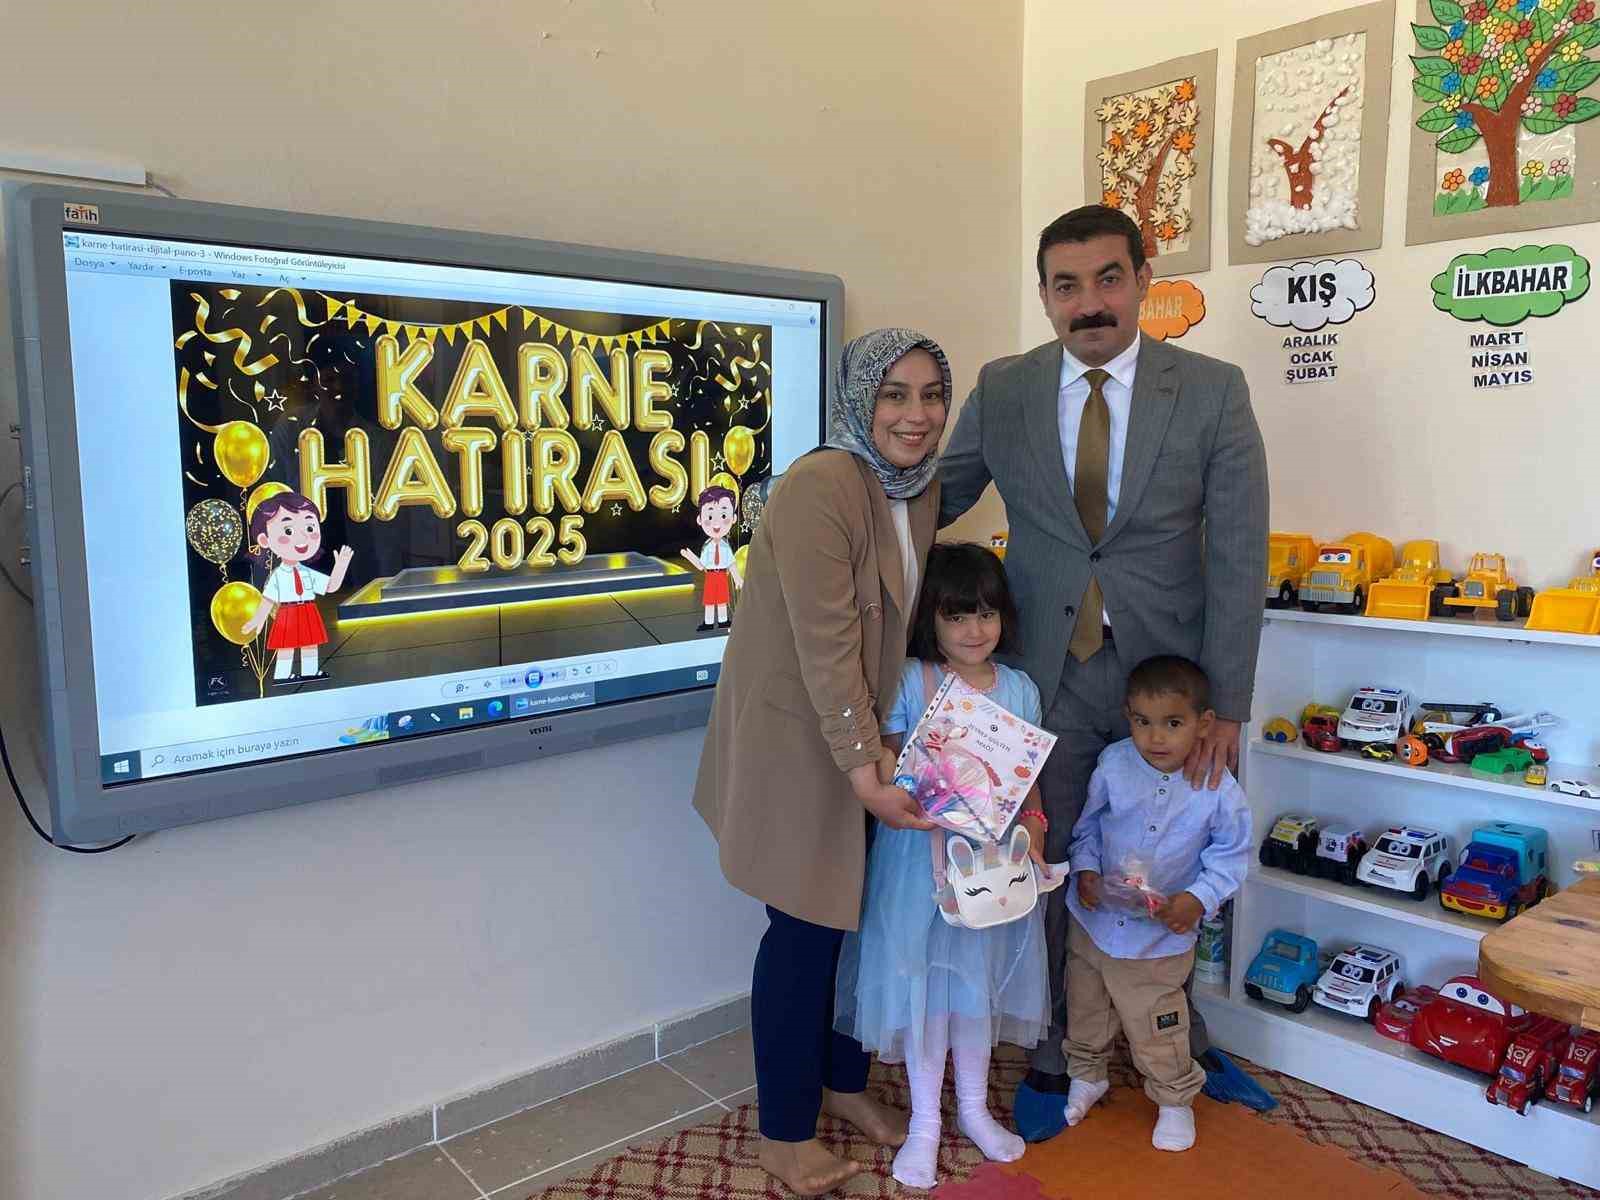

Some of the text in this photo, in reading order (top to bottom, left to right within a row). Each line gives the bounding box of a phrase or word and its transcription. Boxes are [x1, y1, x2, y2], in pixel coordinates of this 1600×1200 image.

[64, 205, 98, 221] fatih
[74, 257, 105, 270] Dosya
[213, 250, 253, 262] Windows
[254, 254, 289, 266] Fotoğraf
[1456, 265, 1568, 297] İLKBAHAR
[1288, 273, 1337, 308] KIŞ
[1139, 295, 1183, 321] BAHAR
[1282, 333, 1338, 349] ARALIK
[1470, 331, 1523, 347] MART
[1290, 351, 1333, 364] OCAK
[1471, 351, 1528, 368] NİSAN
[1286, 366, 1338, 383] ŞUBAT
[1473, 370, 1533, 388] MAYIS
[375, 334, 674, 433] KARNE
[297, 426, 710, 523] HATIRASI
[456, 514, 587, 572] 2025
[173, 737, 300, 764] Aramak için buraya yazın
